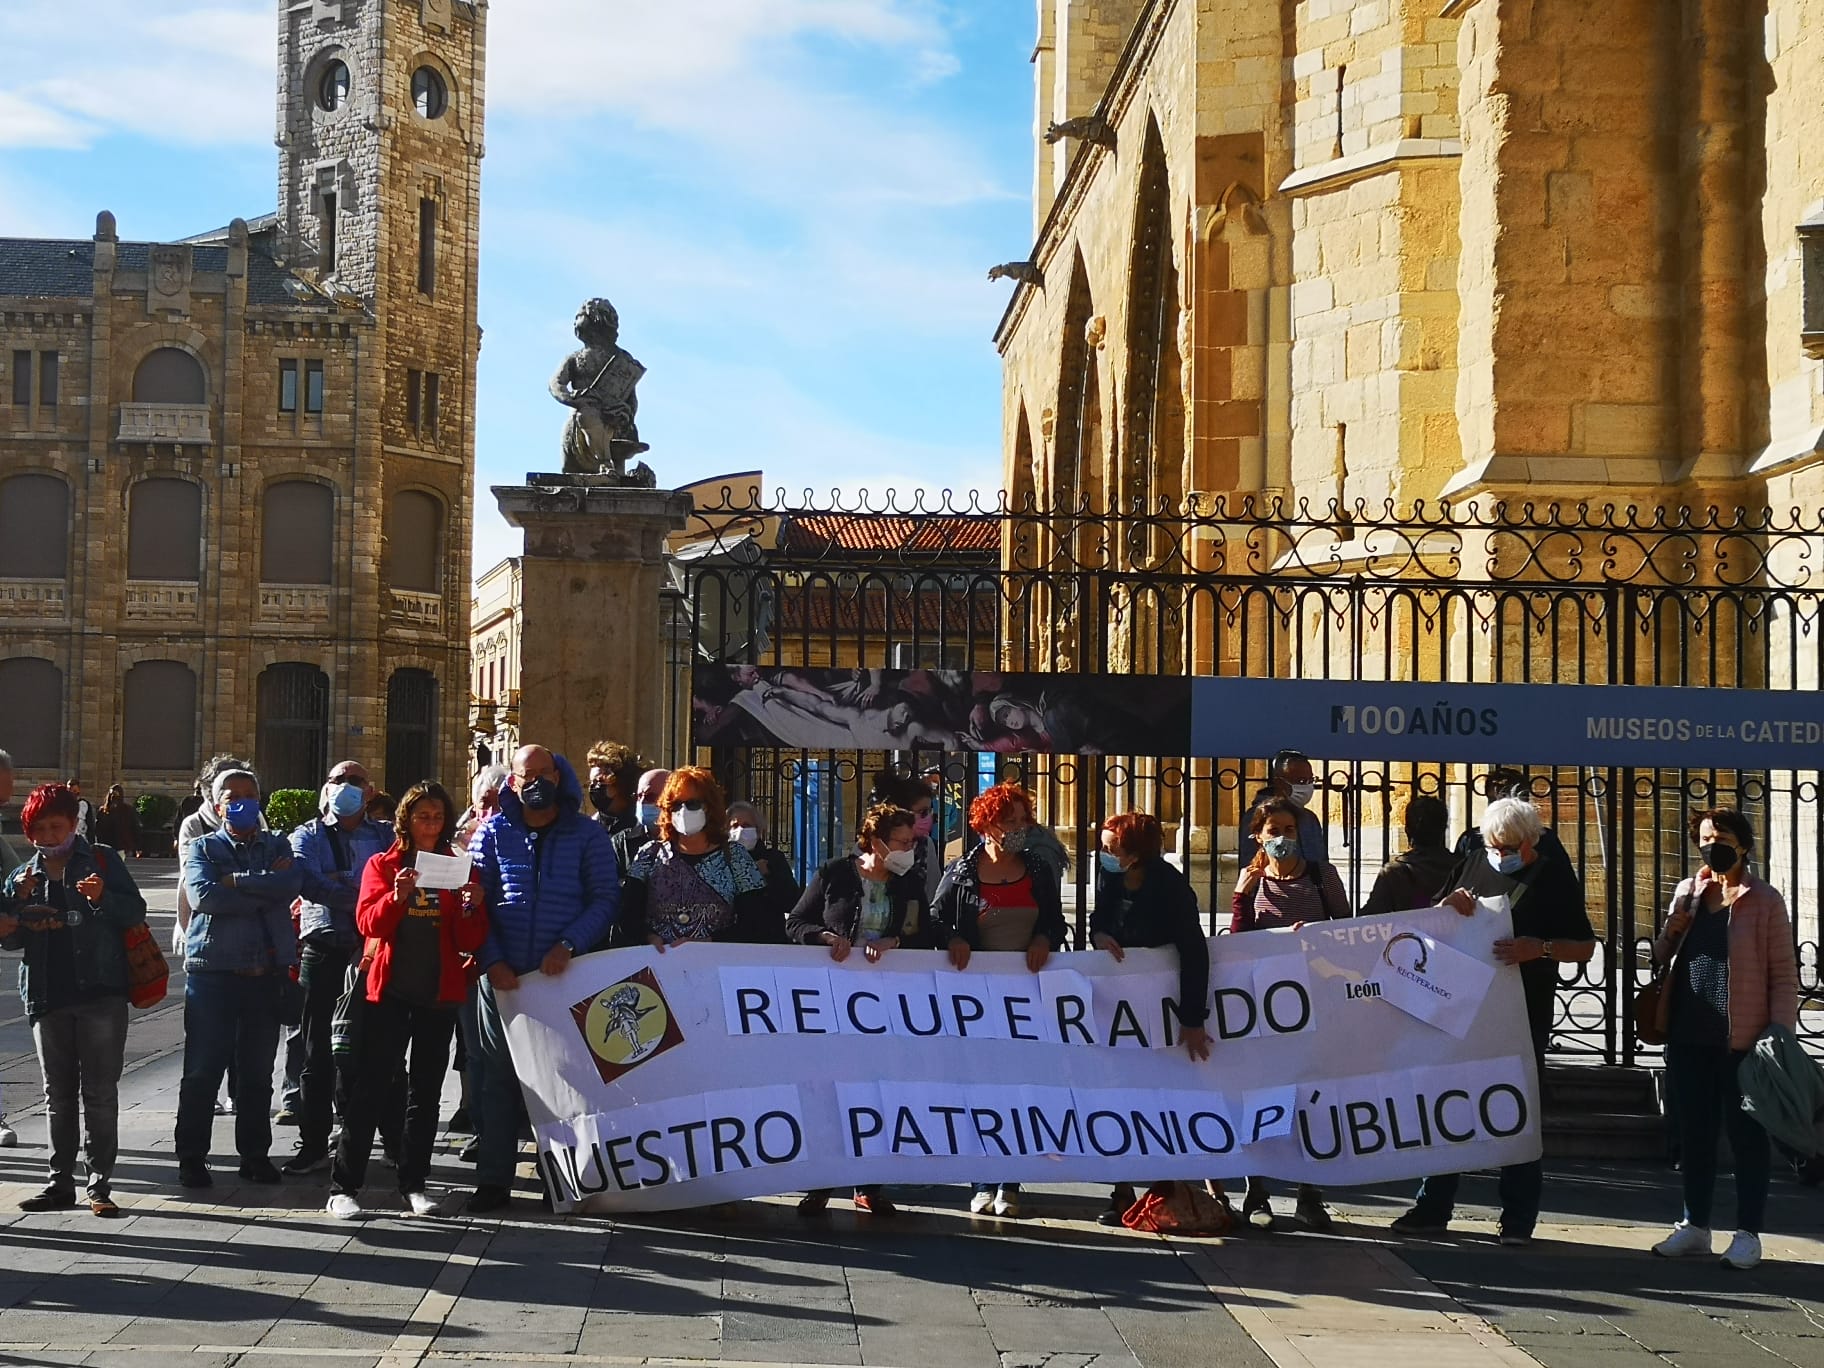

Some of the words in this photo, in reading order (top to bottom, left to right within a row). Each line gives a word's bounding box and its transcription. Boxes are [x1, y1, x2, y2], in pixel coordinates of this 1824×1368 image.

[1586, 717, 1691, 741] MUSEOS
[1696, 725, 1713, 738] DE
[1717, 726, 1735, 739] LA
[1740, 720, 1824, 744] CATED
[1346, 980, 1381, 999] León
[1396, 966, 1452, 1000] RECUPERANDO
[736, 980, 1311, 1048] RECUPERANDO
[544, 1110, 801, 1202] NUESTRO
[848, 1106, 1235, 1157] PATRIMONIO
